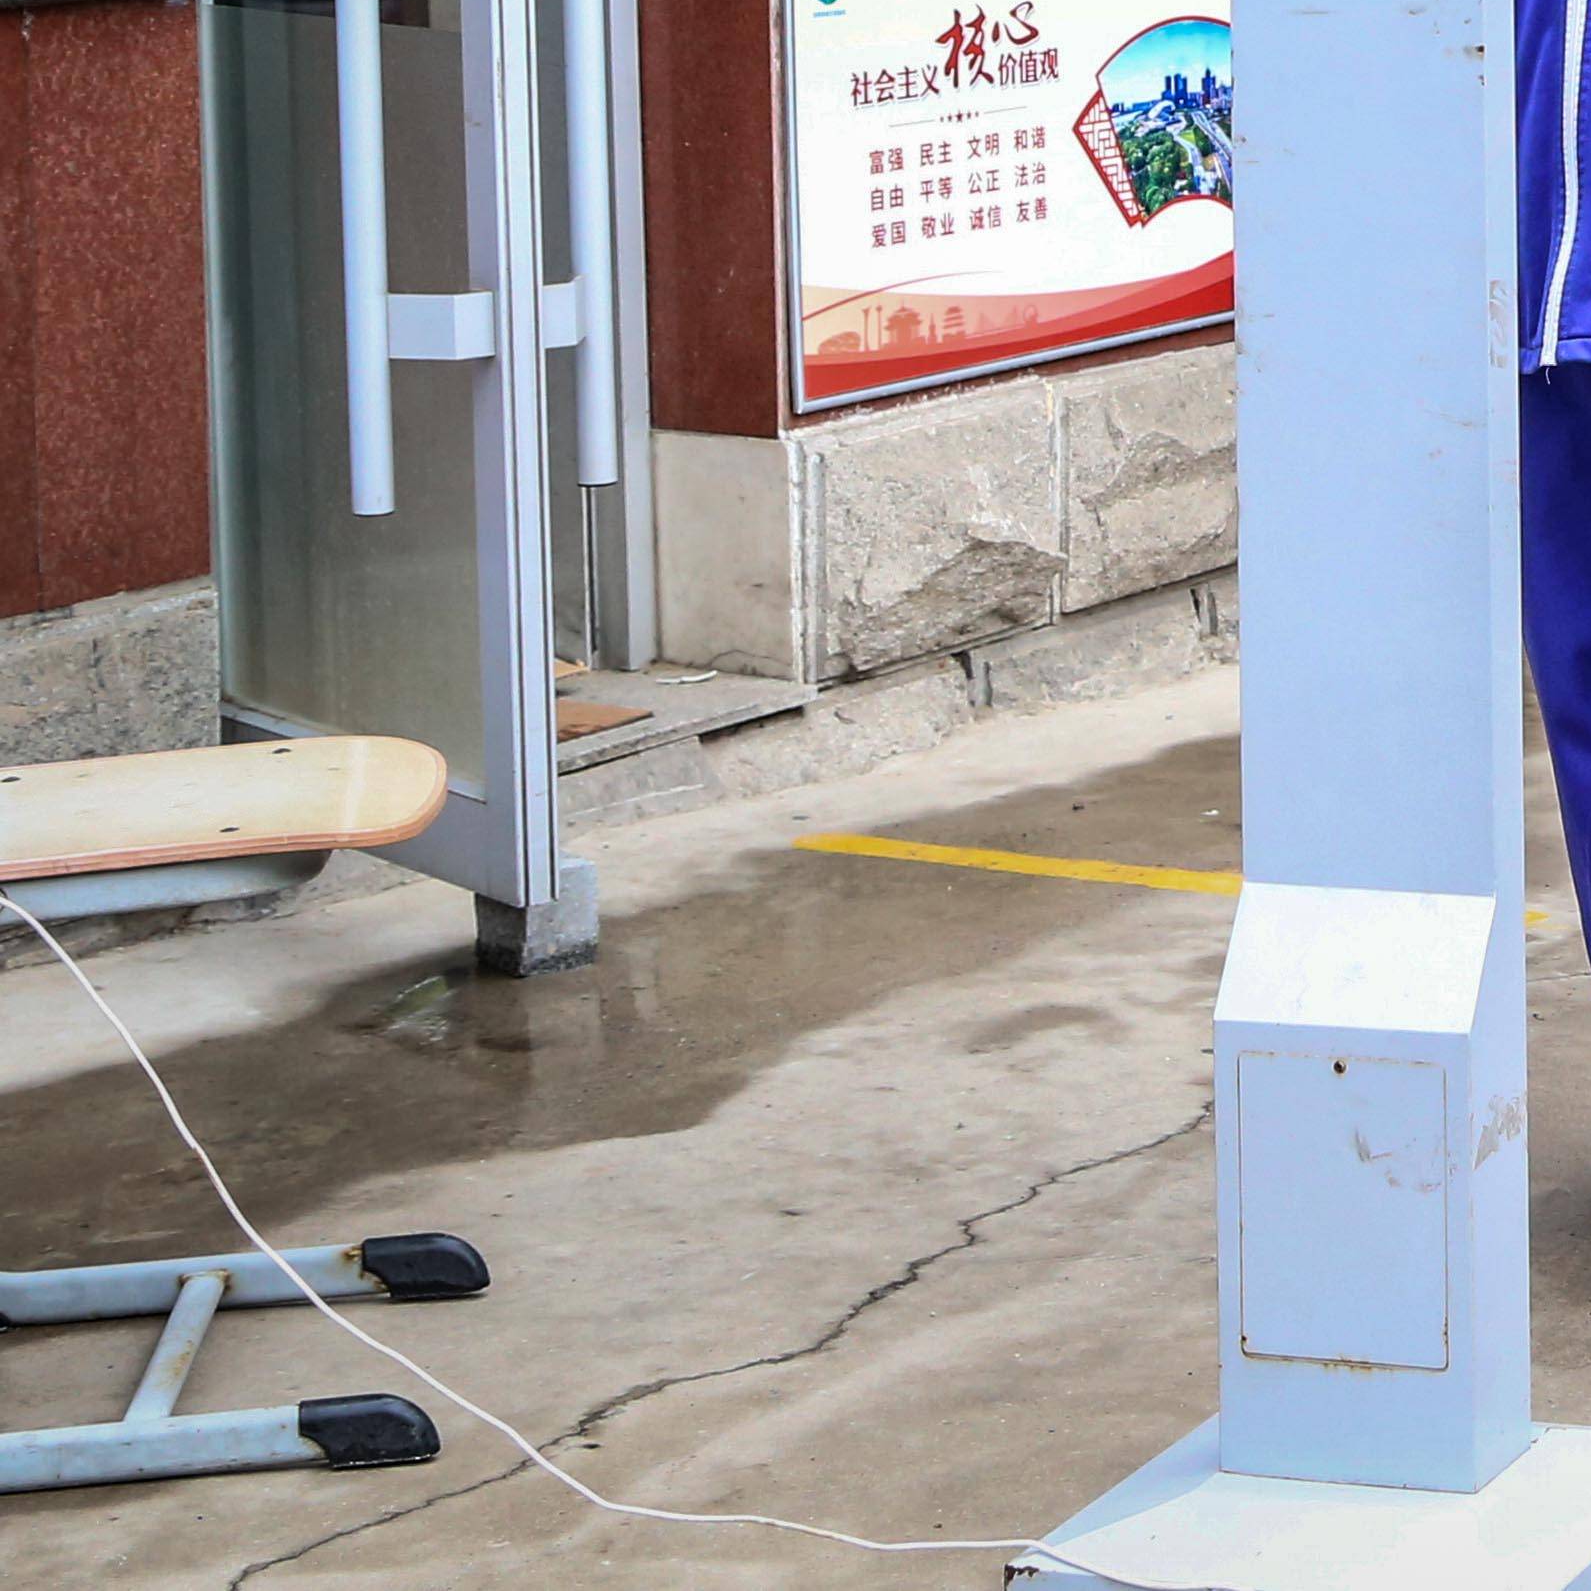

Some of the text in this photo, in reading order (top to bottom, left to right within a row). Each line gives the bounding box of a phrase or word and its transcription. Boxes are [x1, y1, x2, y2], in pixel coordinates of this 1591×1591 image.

[869, 126, 1046, 175] 富强 民主 文明 和谐
[870, 161, 1047, 212] 自由 平等 公正 法治
[871, 197, 1049, 248] 爱国 敬业 诚信 友善
